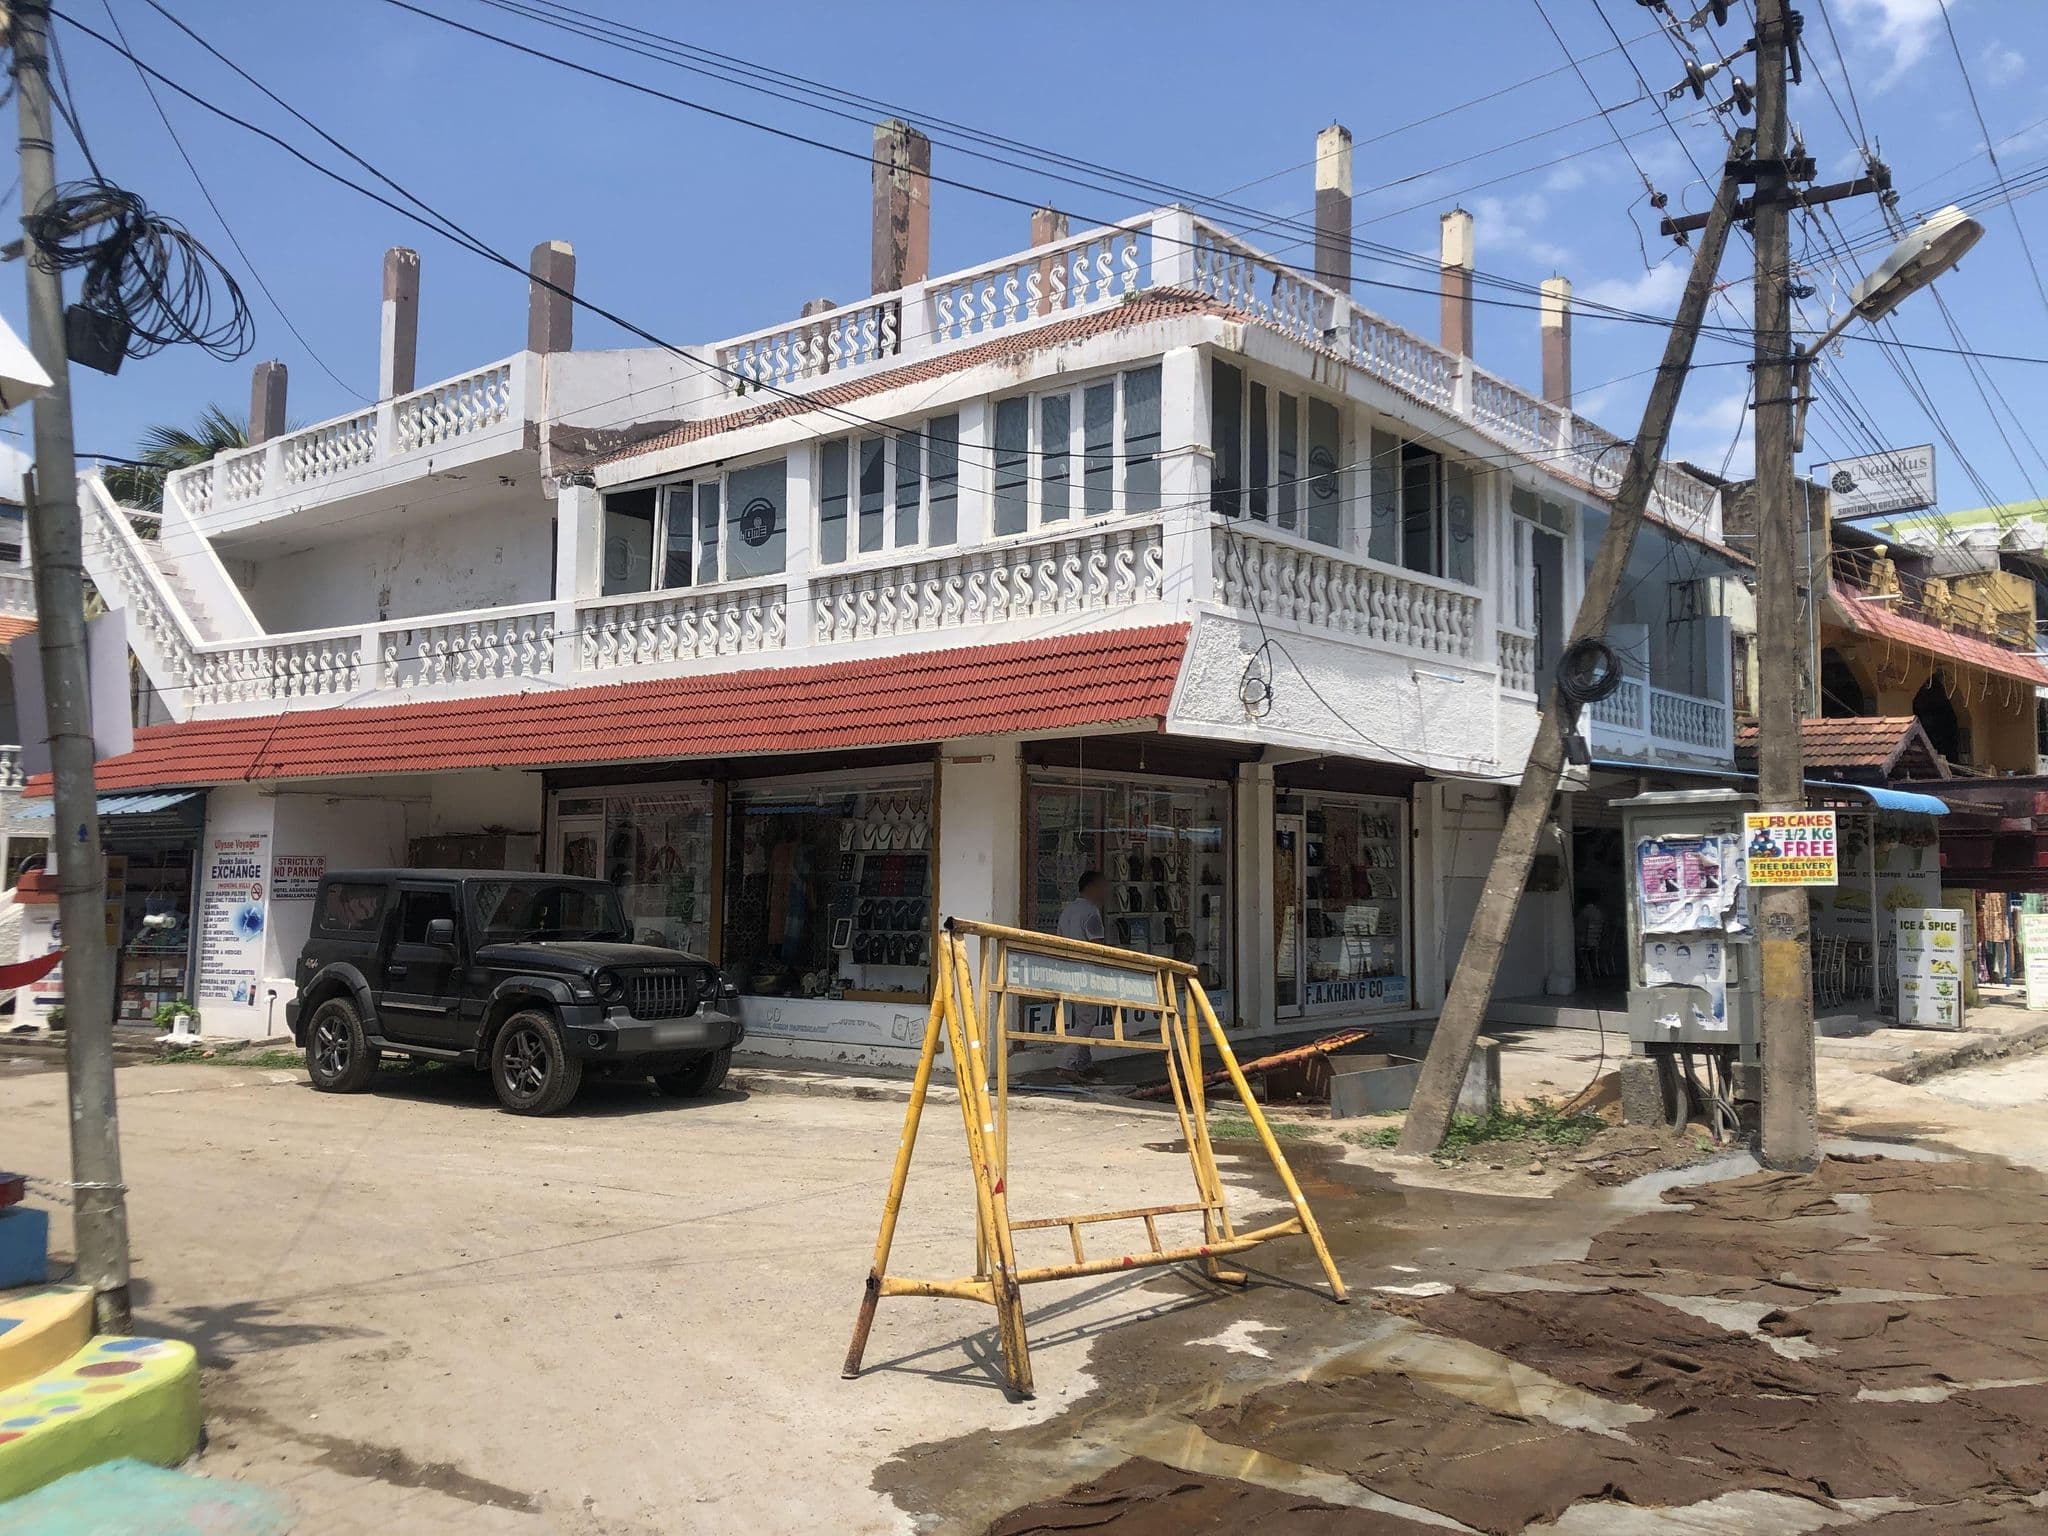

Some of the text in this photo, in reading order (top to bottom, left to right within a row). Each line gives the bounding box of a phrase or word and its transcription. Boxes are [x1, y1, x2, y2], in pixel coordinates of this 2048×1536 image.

[1852, 456, 1927, 481] Nautilus
[1767, 816, 1786, 827] FB
[1788, 815, 1833, 827] CAKES
[1785, 828, 1807, 840] 1/2
[1812, 828, 1833, 840] KG
[236, 839, 260, 850] Voyages
[1784, 841, 1834, 857] FREE
[212, 865, 261, 879] EXCHANGE
[274, 867, 323, 877] NO PARKING
[1900, 920, 1916, 930] ICE
[1919, 921, 1925, 930] &
[1928, 922, 1957, 931] SPICE
[1008, 954, 1029, 986] E1
[1305, 982, 1356, 1005] F.A.KHAN
[1359, 981, 1366, 999] &
[1369, 979, 1383, 998] CO
